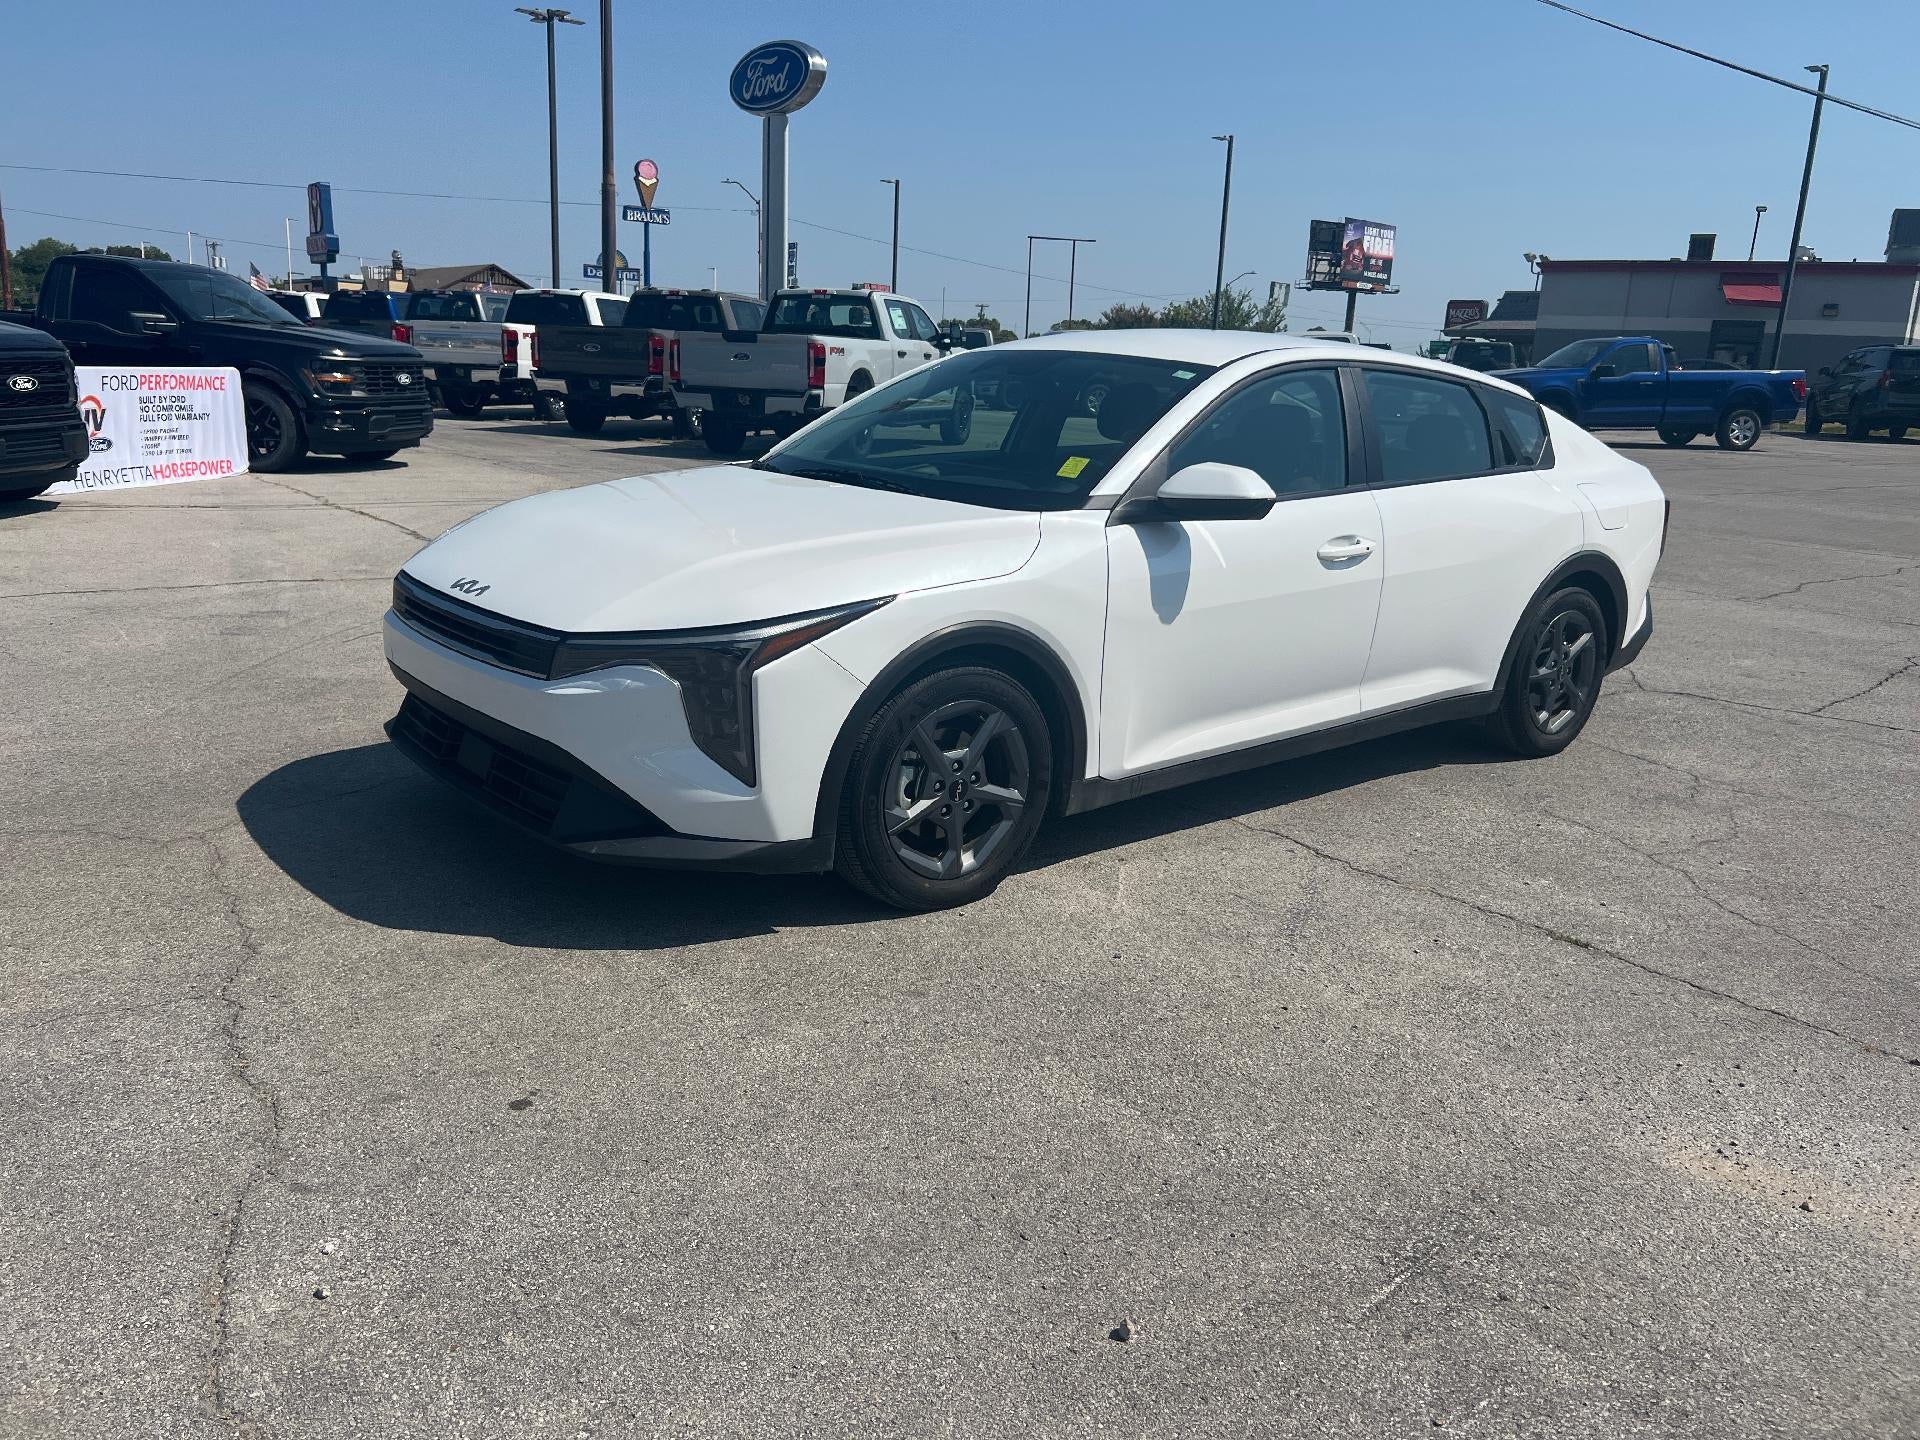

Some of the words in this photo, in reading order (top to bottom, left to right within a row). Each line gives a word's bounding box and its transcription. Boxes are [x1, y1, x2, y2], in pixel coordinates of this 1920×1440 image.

[743, 56, 790, 100] Ford
[627, 209, 670, 224] BRAUM'S
[1364, 226, 1379, 236] LIGHT
[1380, 229, 1394, 239] YOUR
[1363, 235, 1394, 256] FIRE!
[587, 267, 603, 277] Da
[15, 378, 33, 389] Ford
[139, 395, 156, 404] BUILT
[158, 395, 168, 404] BY
[140, 405, 150, 413] NO
[140, 413, 156, 422] FULL
[174, 412, 211, 421] WARRANTY
